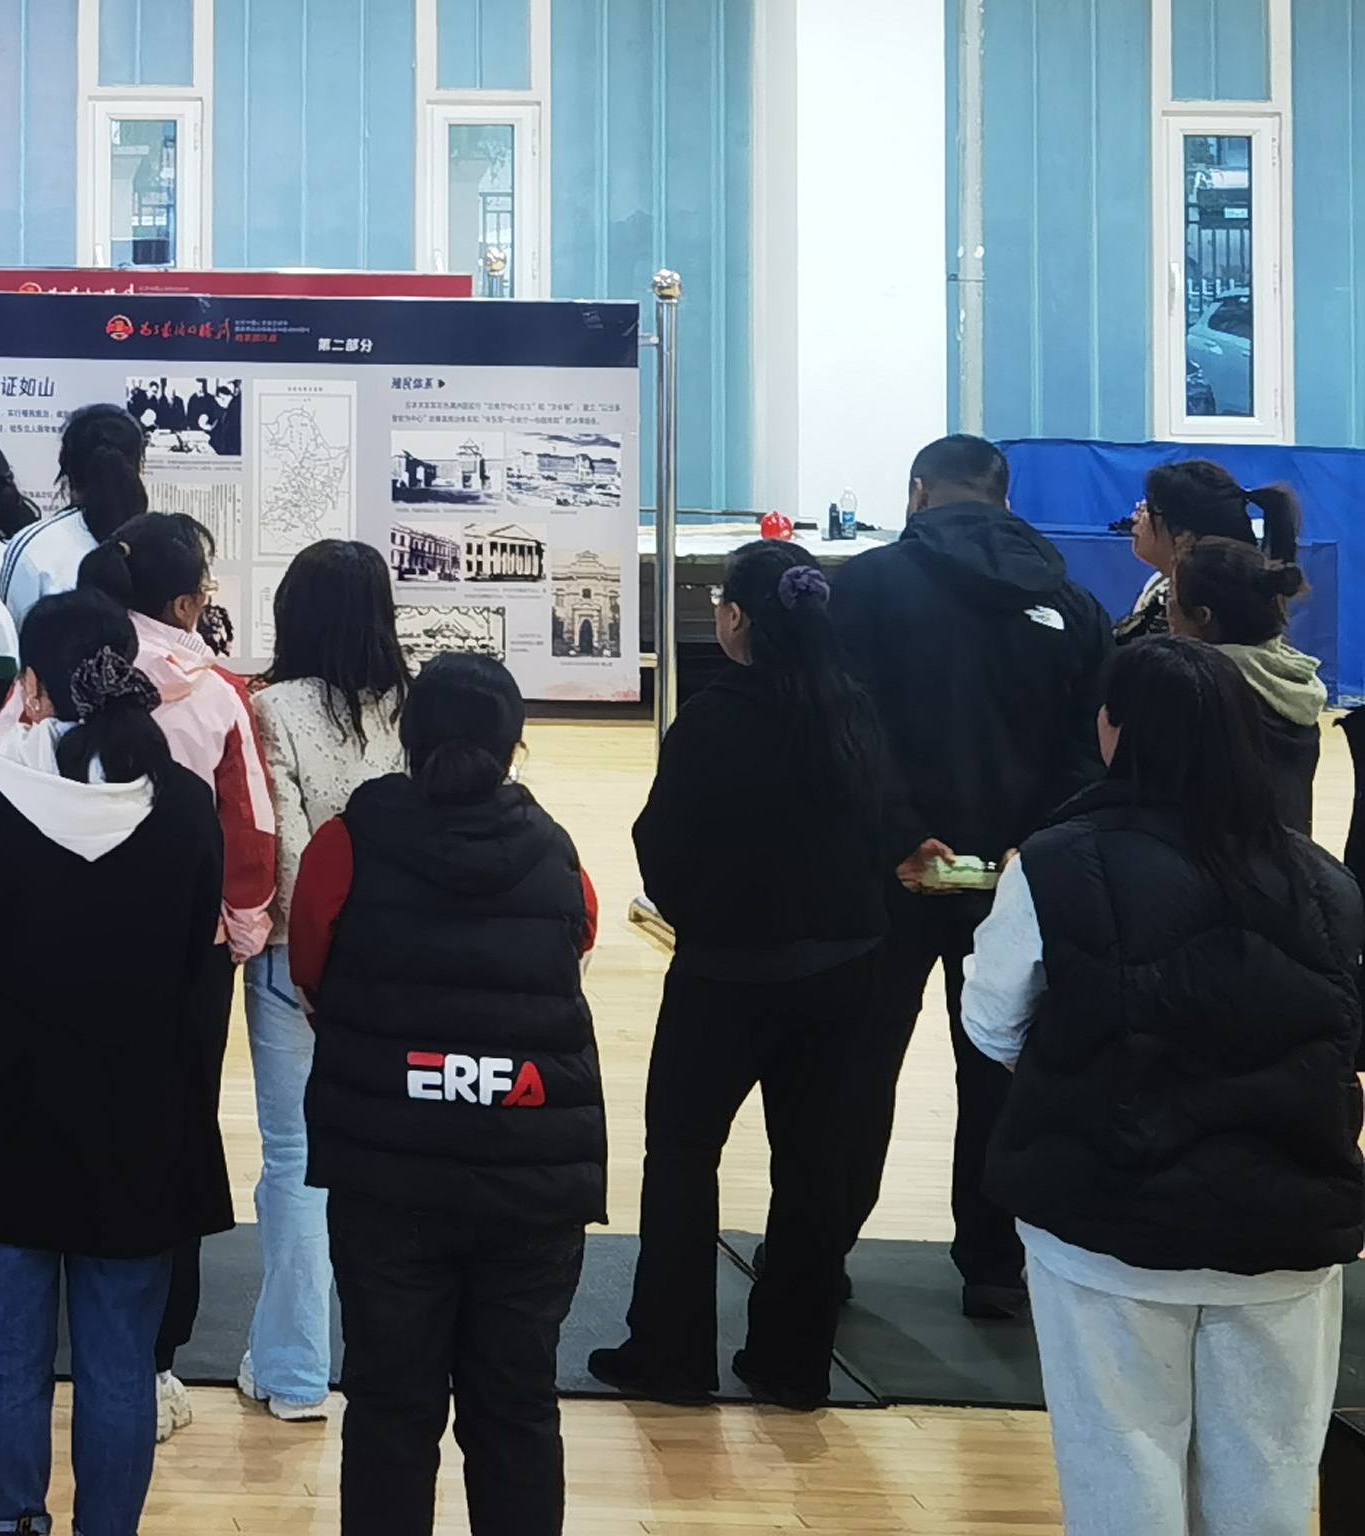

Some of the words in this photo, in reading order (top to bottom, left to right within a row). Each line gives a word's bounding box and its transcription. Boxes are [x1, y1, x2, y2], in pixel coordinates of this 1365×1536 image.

[317, 338, 374, 353] 第二部分
[407, 1051, 546, 1107] ERFA
